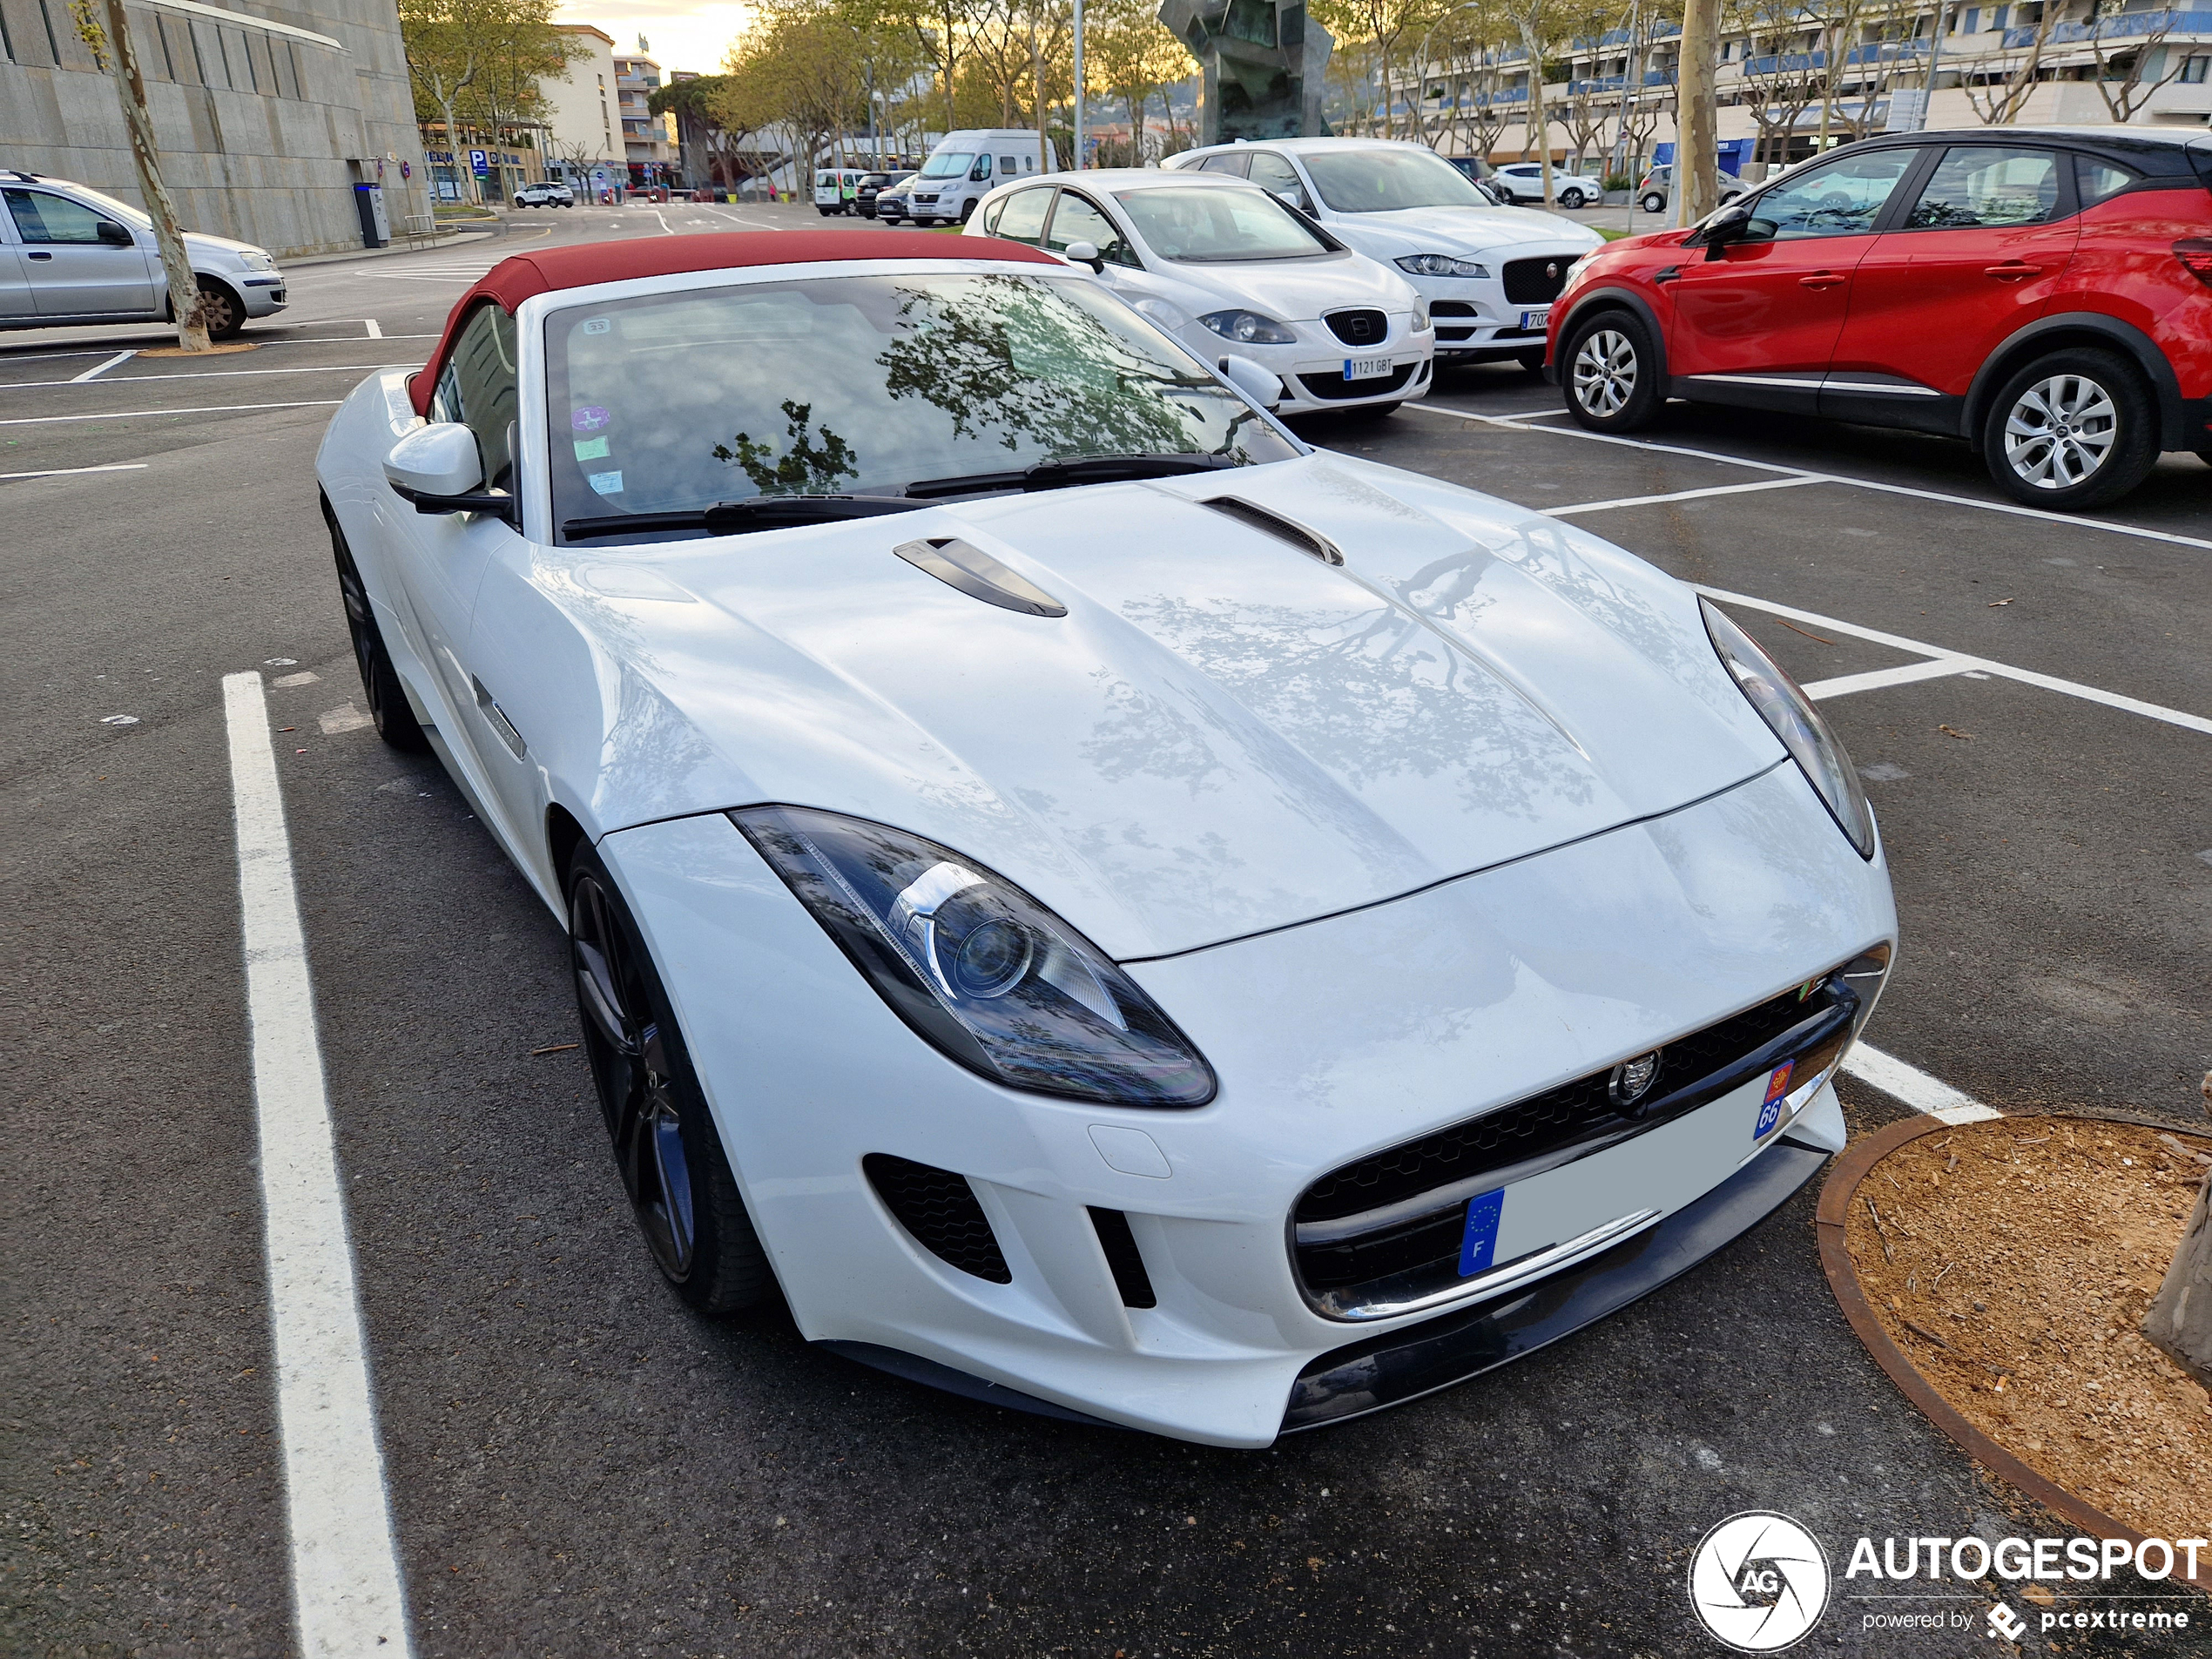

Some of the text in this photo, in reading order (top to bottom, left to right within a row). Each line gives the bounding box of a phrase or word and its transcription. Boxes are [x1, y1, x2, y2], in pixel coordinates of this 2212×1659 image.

[471, 151, 484, 166] P
[1353, 361, 1373, 374] 1121
[1376, 358, 1392, 372] GBT
[1759, 1099, 1780, 1130] 66
[1472, 1239, 1485, 1258] F
